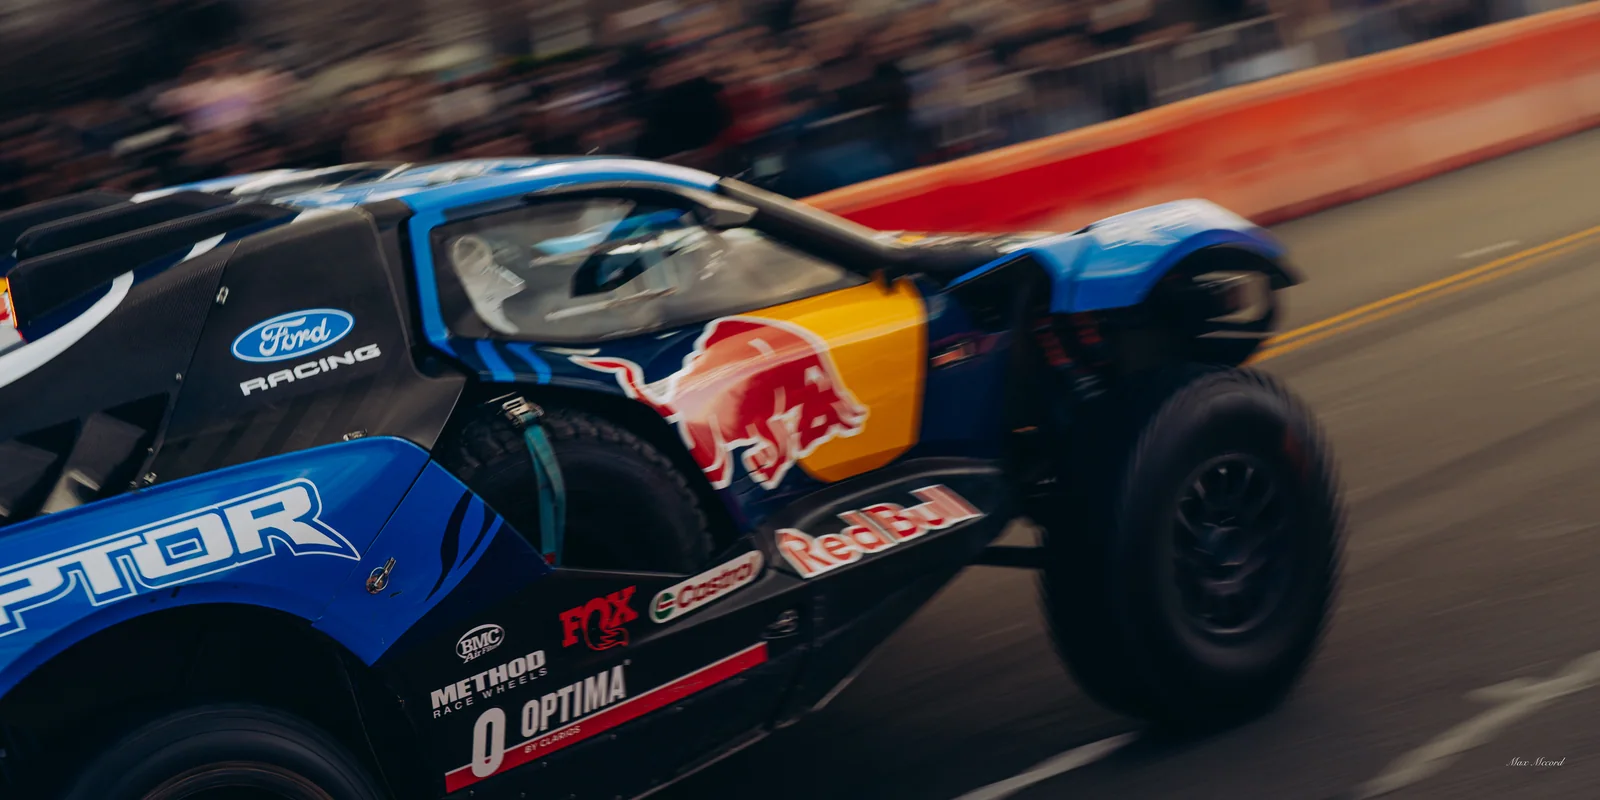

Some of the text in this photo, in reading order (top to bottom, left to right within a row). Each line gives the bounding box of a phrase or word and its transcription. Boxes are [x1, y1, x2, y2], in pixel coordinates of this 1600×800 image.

[259, 316, 331, 357] Ford
[240, 343, 382, 396] RACING
[677, 557, 757, 608] Castrol
[460, 628, 501, 655] BMC
[559, 585, 639, 650] FOX
[430, 650, 546, 710] METHOD
[463, 649, 482, 664] Air
[433, 668, 548, 719] RACE WHEELS
[521, 664, 627, 738] OPTIMA
[524, 725, 581, 753] BY CLARIOS
